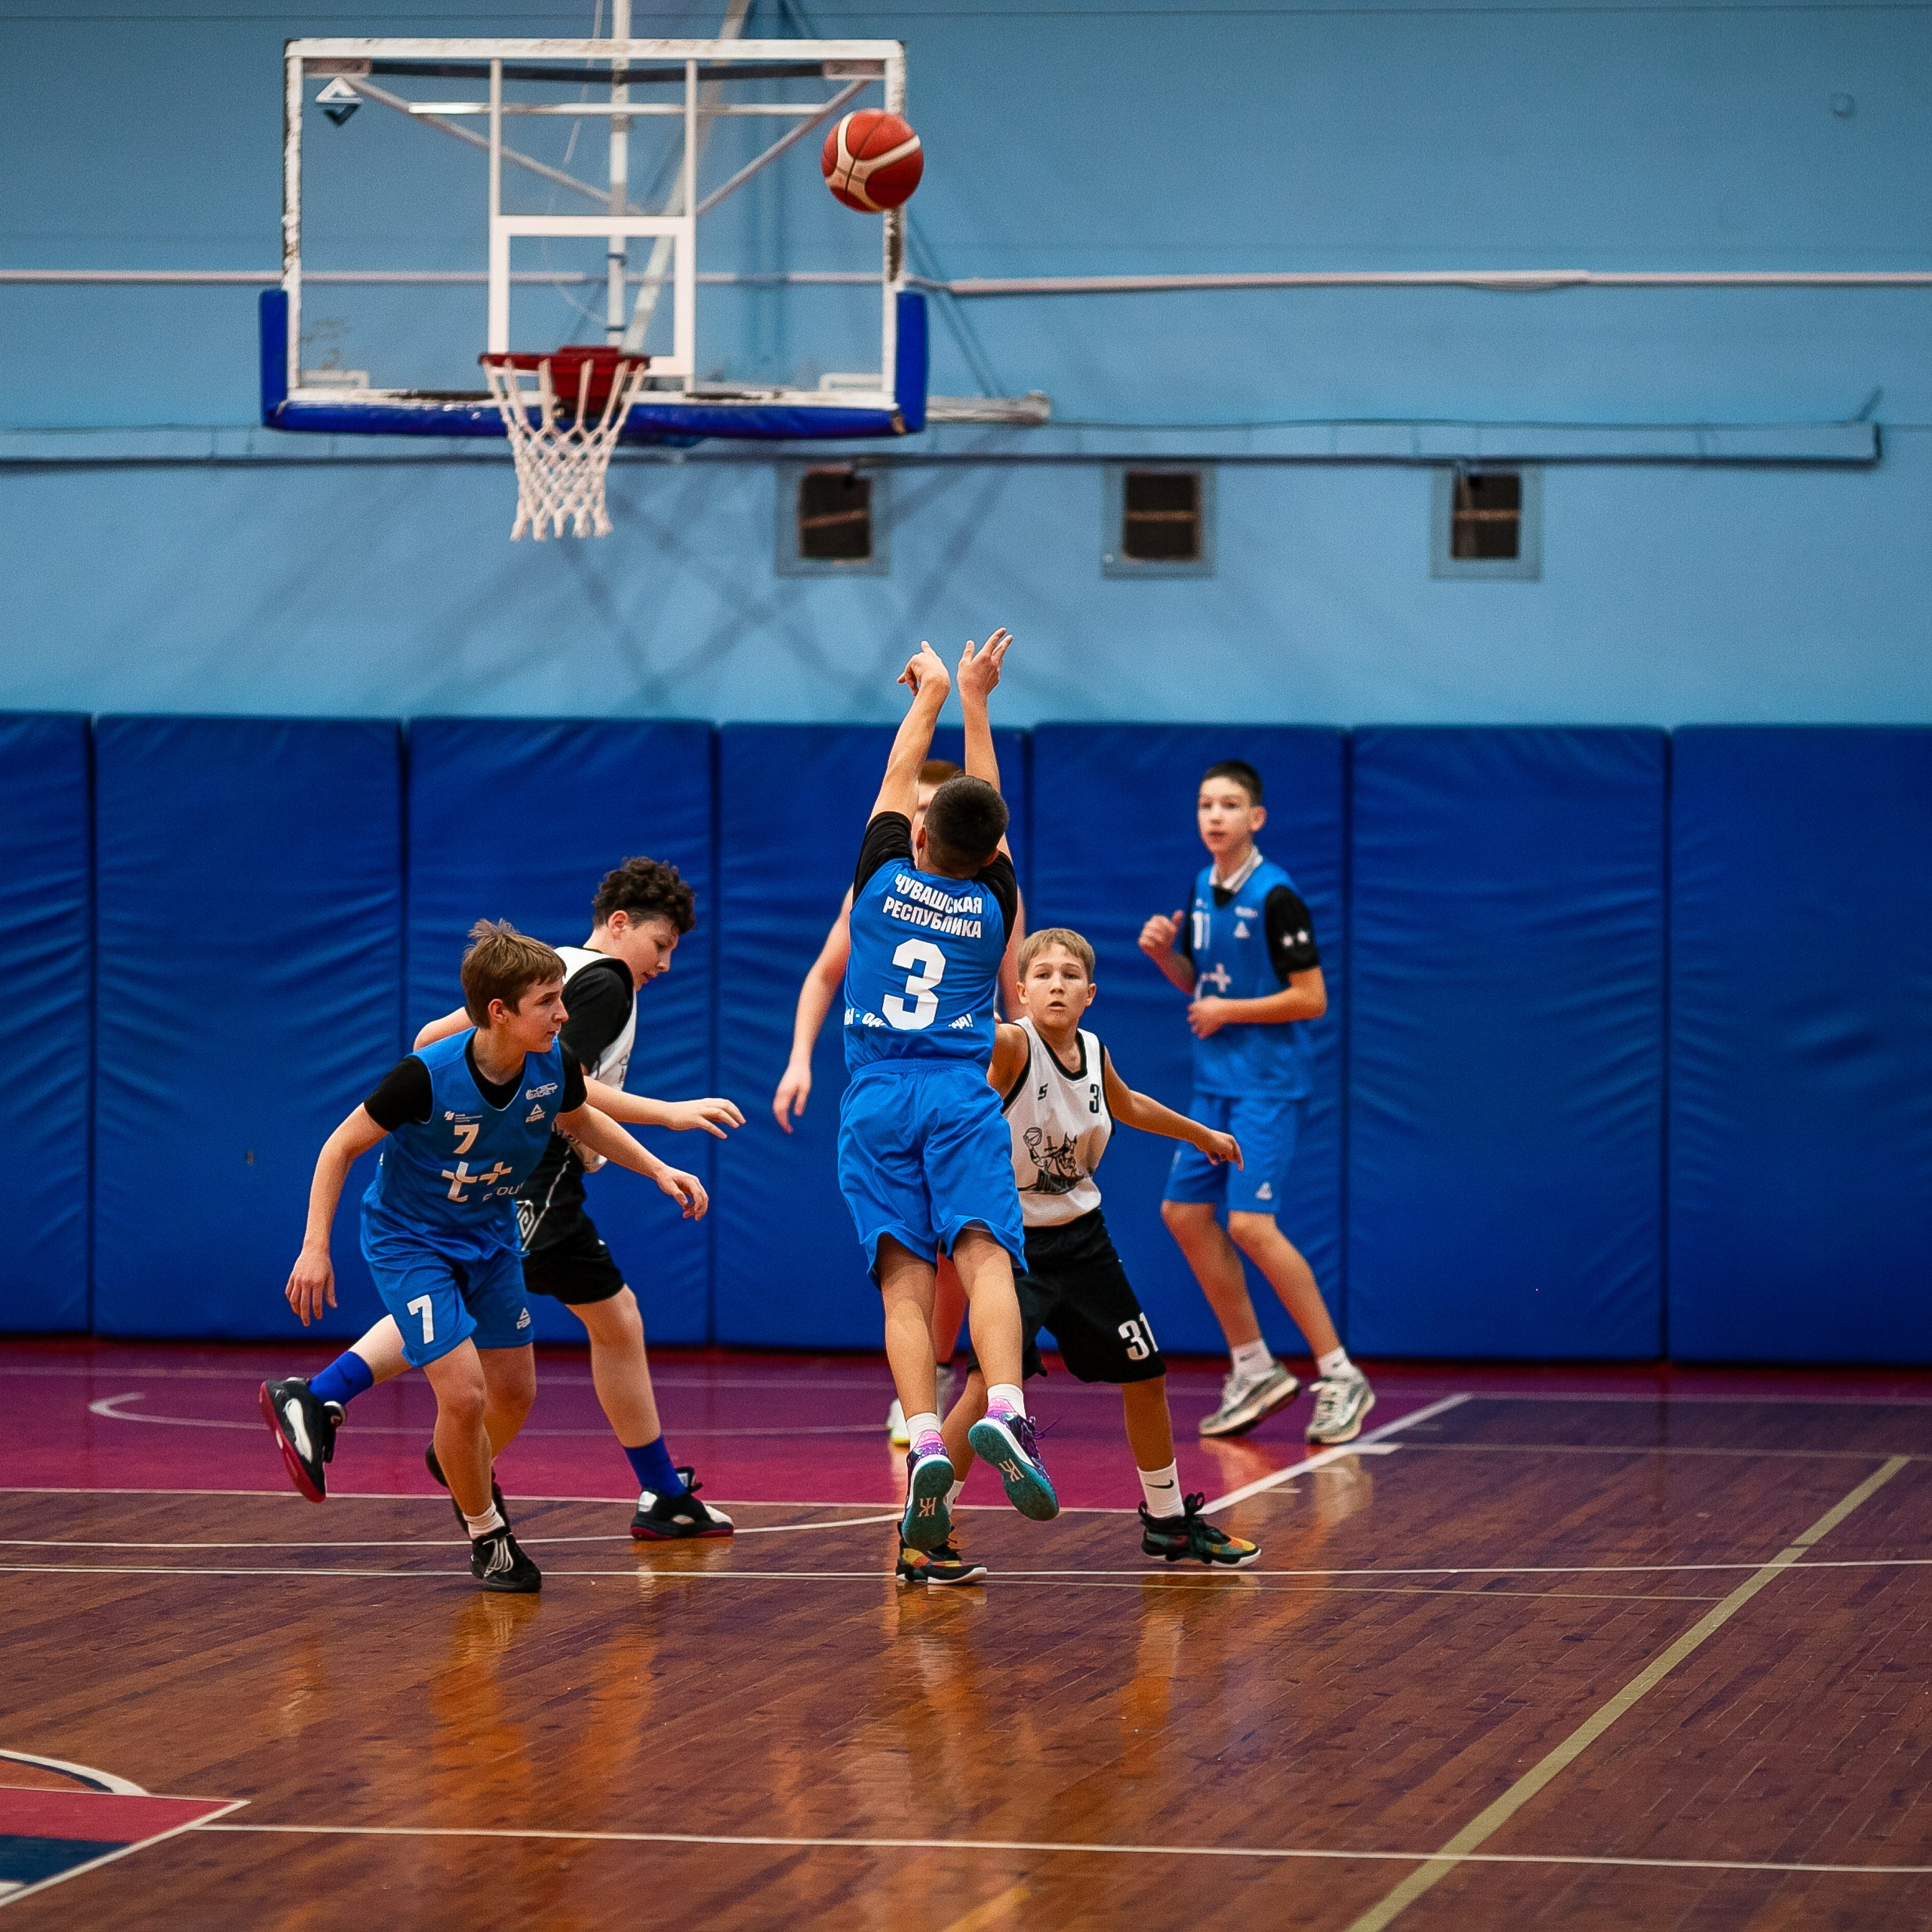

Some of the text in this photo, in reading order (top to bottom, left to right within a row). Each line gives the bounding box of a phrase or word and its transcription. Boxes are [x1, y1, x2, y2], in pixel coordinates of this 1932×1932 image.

[894, 873, 983, 915] ЧУВАШСКАЯ
[882, 896, 982, 939] РЕСПУБЛИКА
[881, 938, 946, 1030] 3
[453, 1123, 480, 1155] 7
[407, 1294, 434, 1345] 7
[1118, 1312, 1159, 1360] 31
